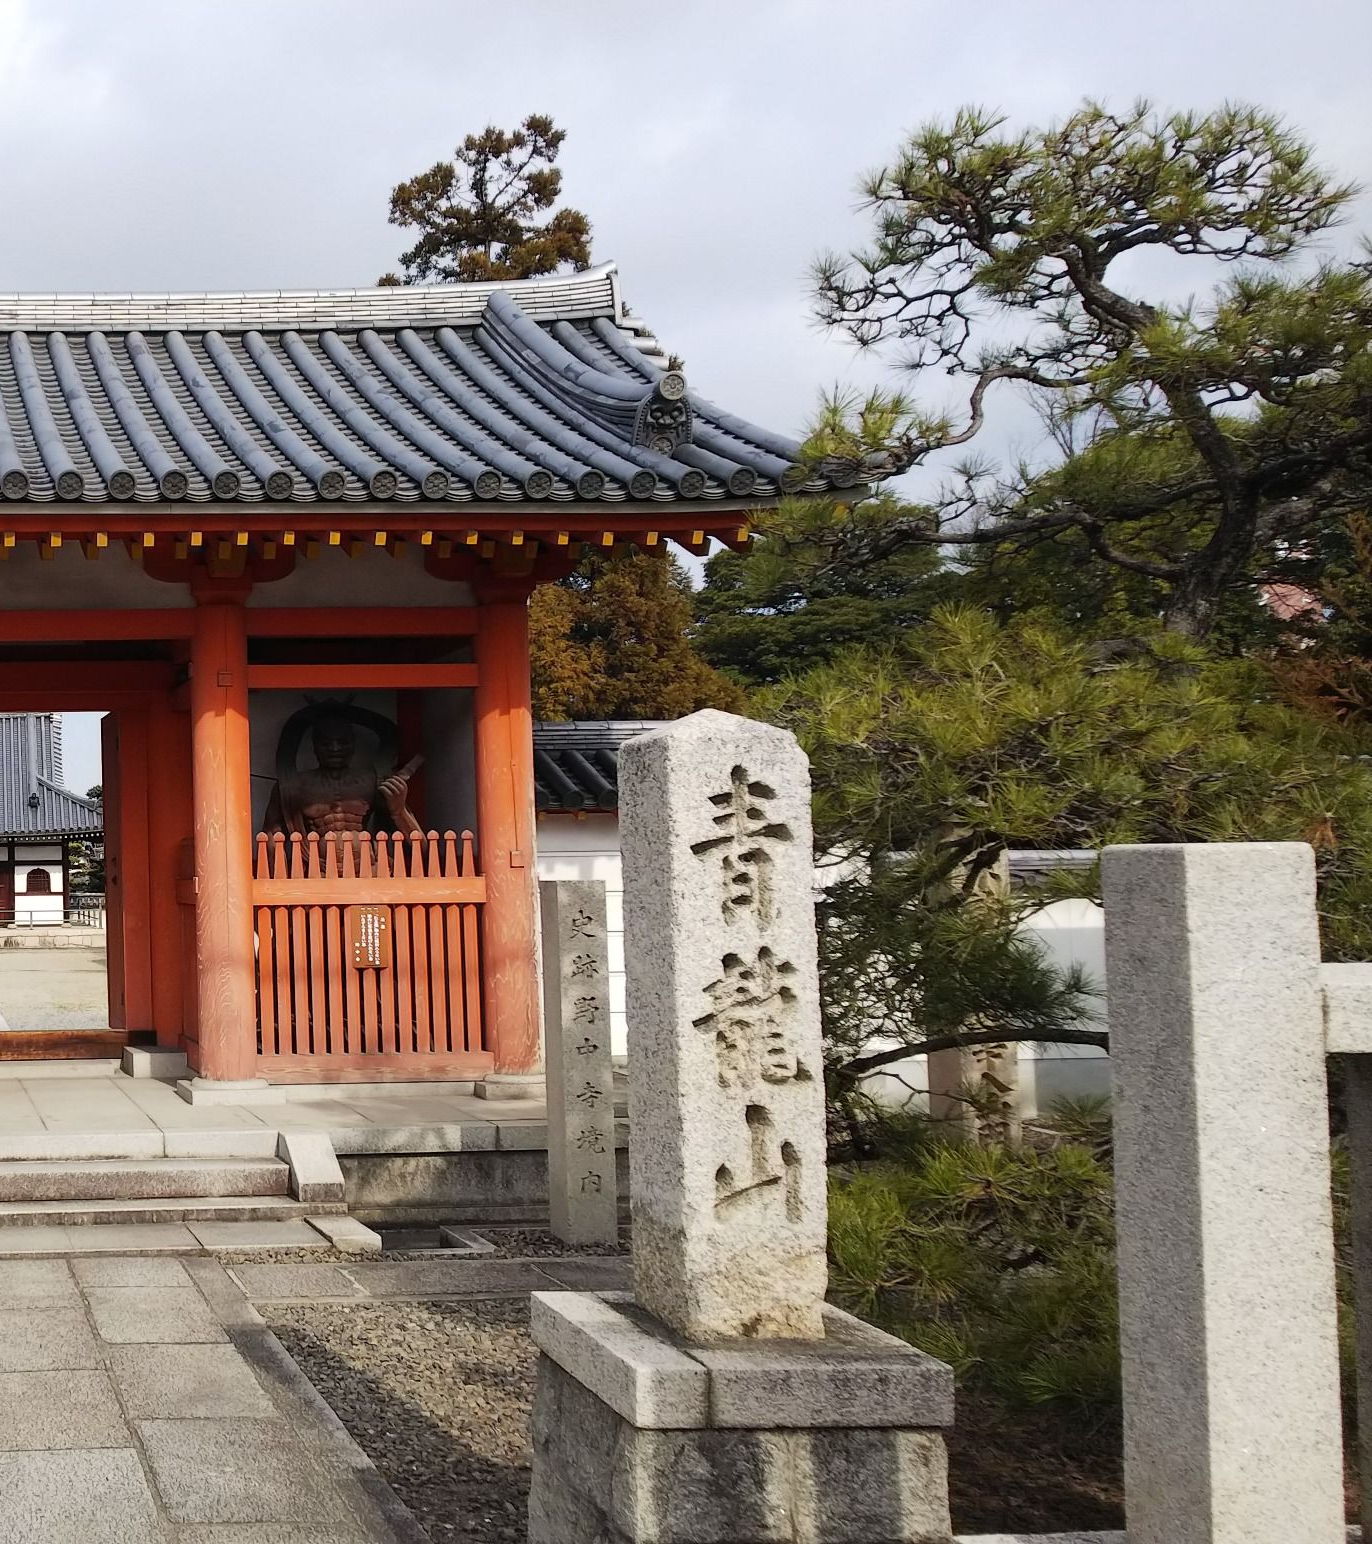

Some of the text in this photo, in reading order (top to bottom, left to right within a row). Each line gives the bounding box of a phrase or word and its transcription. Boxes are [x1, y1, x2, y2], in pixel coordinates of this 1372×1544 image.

[570, 909, 606, 1194] 史跡野中寺境内
[690, 765, 812, 1225] 青龍山
